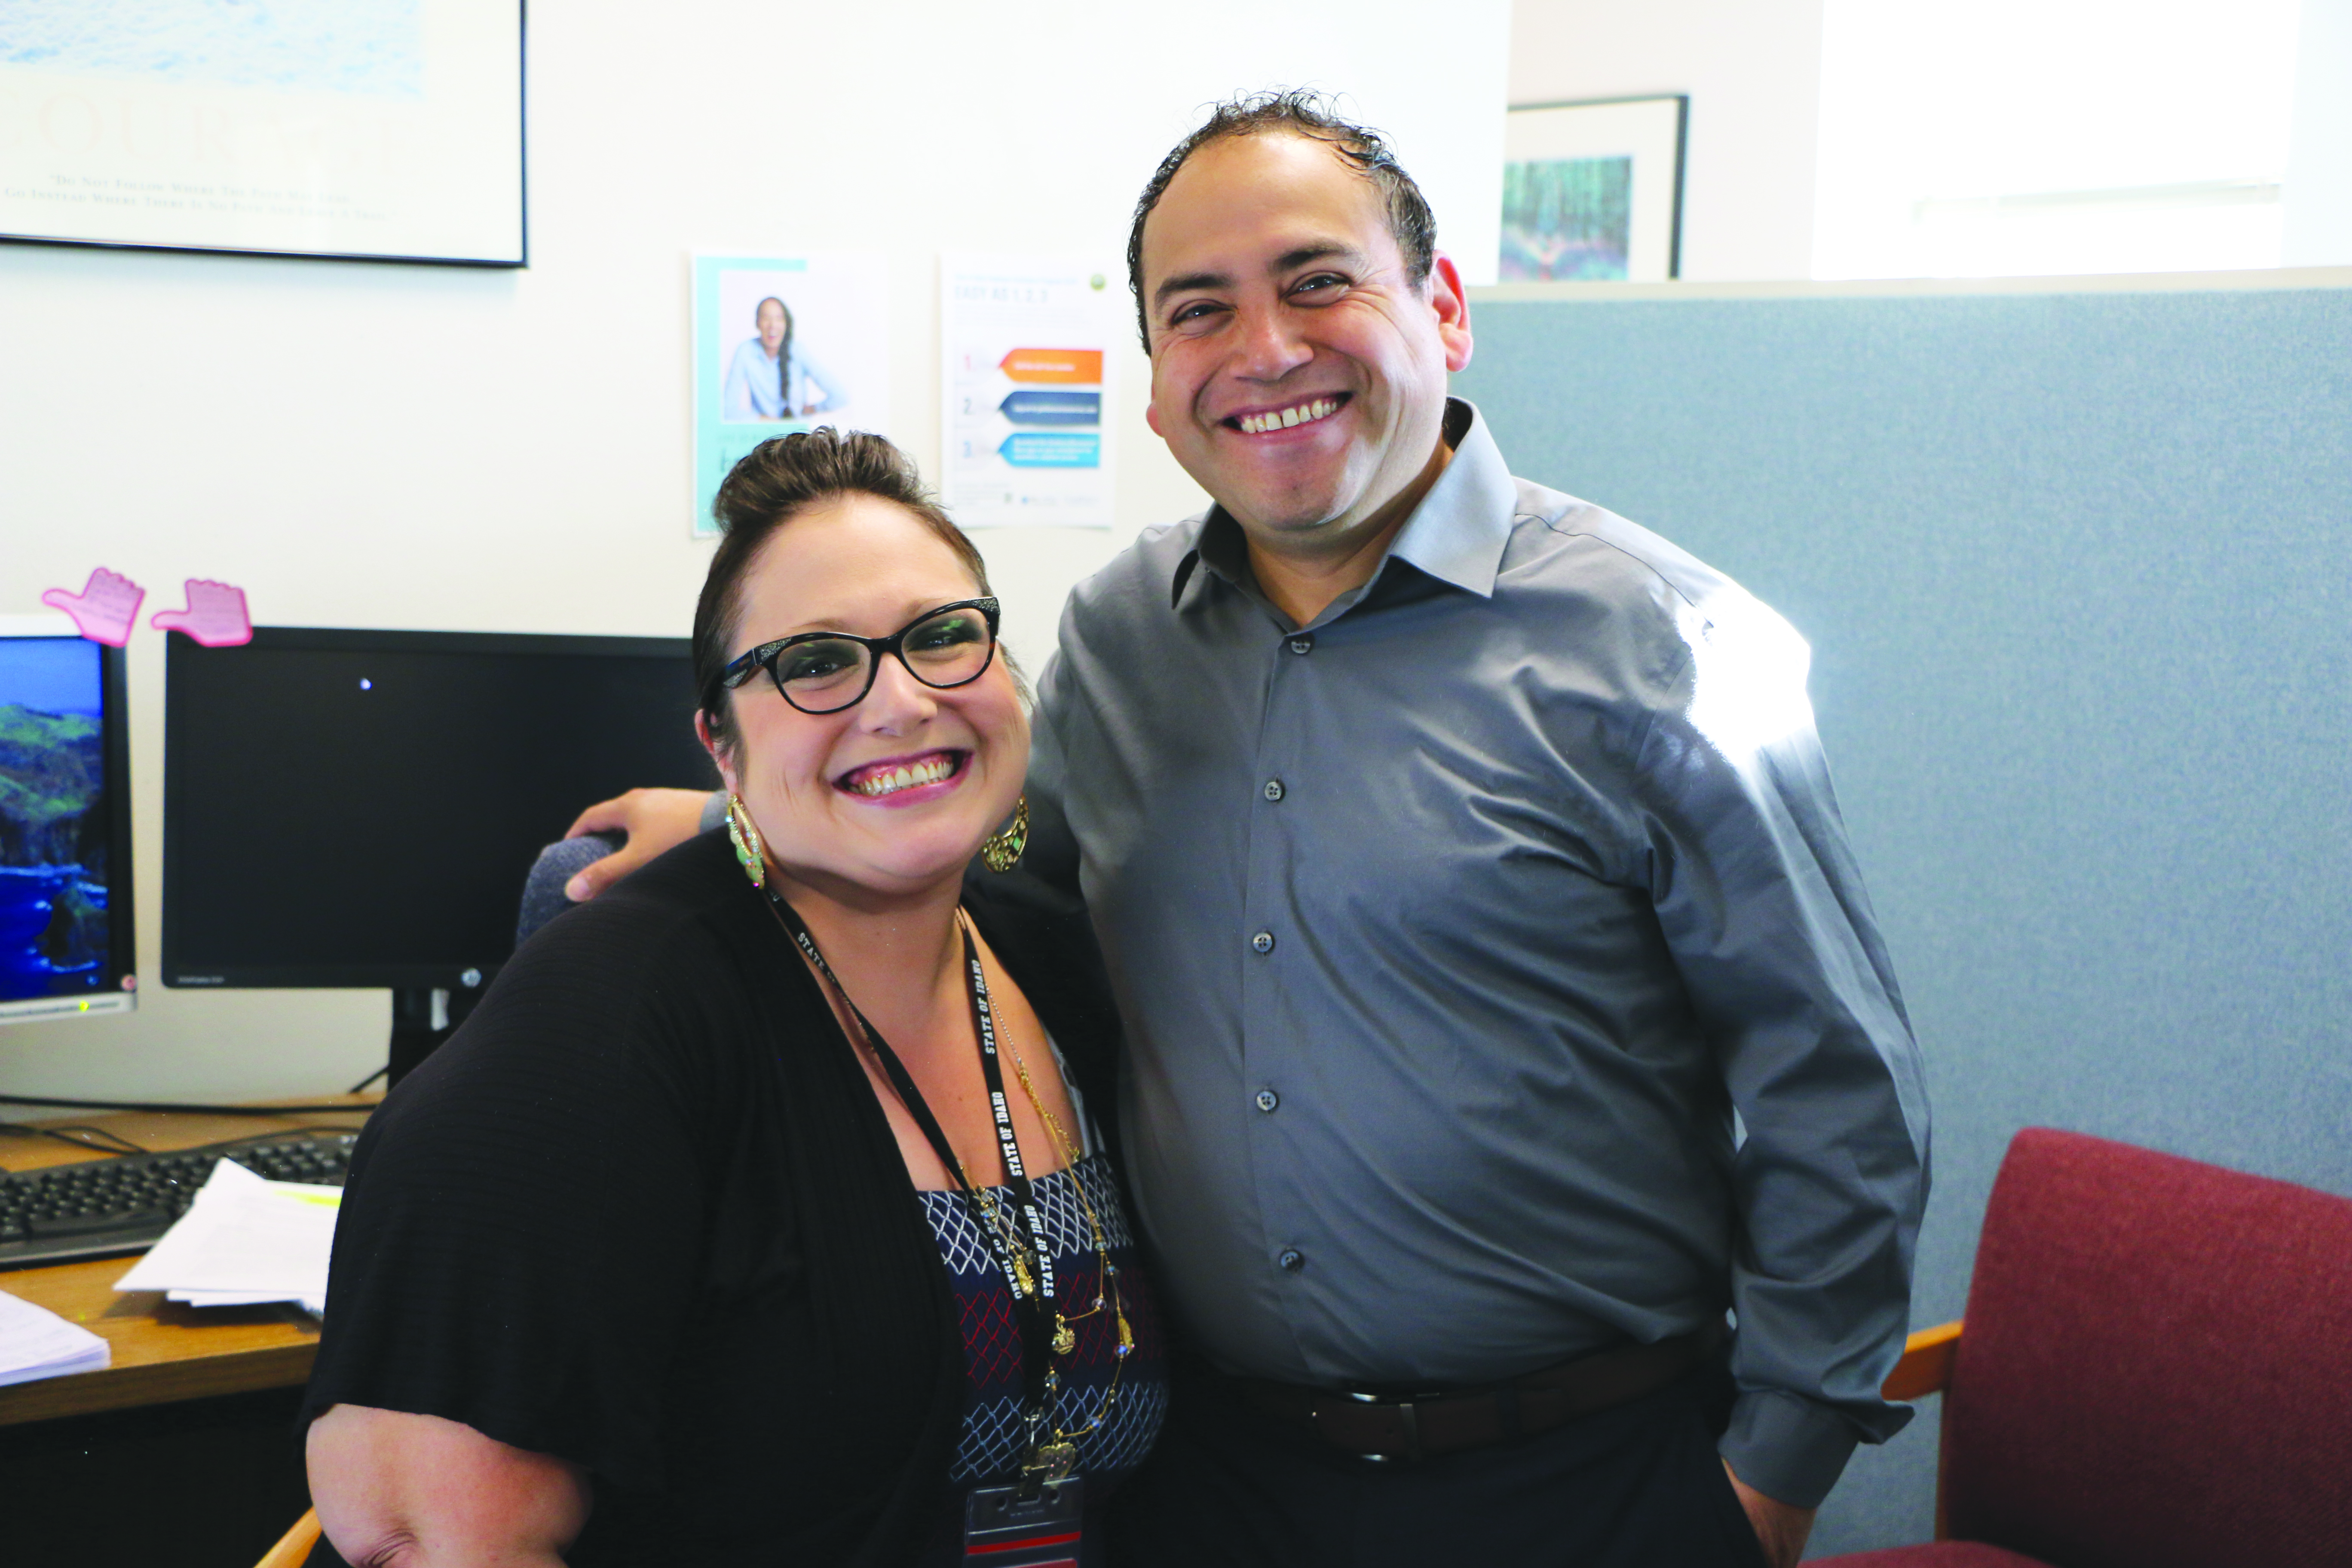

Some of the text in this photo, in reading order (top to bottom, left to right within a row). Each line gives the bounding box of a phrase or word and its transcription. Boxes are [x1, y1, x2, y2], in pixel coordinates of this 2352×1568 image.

[798, 932, 824, 970] STATE
[971, 959, 995, 1054] STATE OF IDAHO
[992, 1092, 1023, 1176] STATE OF IDAHO
[993, 1239, 1023, 1300] OF IDAHO
[1024, 1205, 1054, 1297] STATE OF IDAHO
